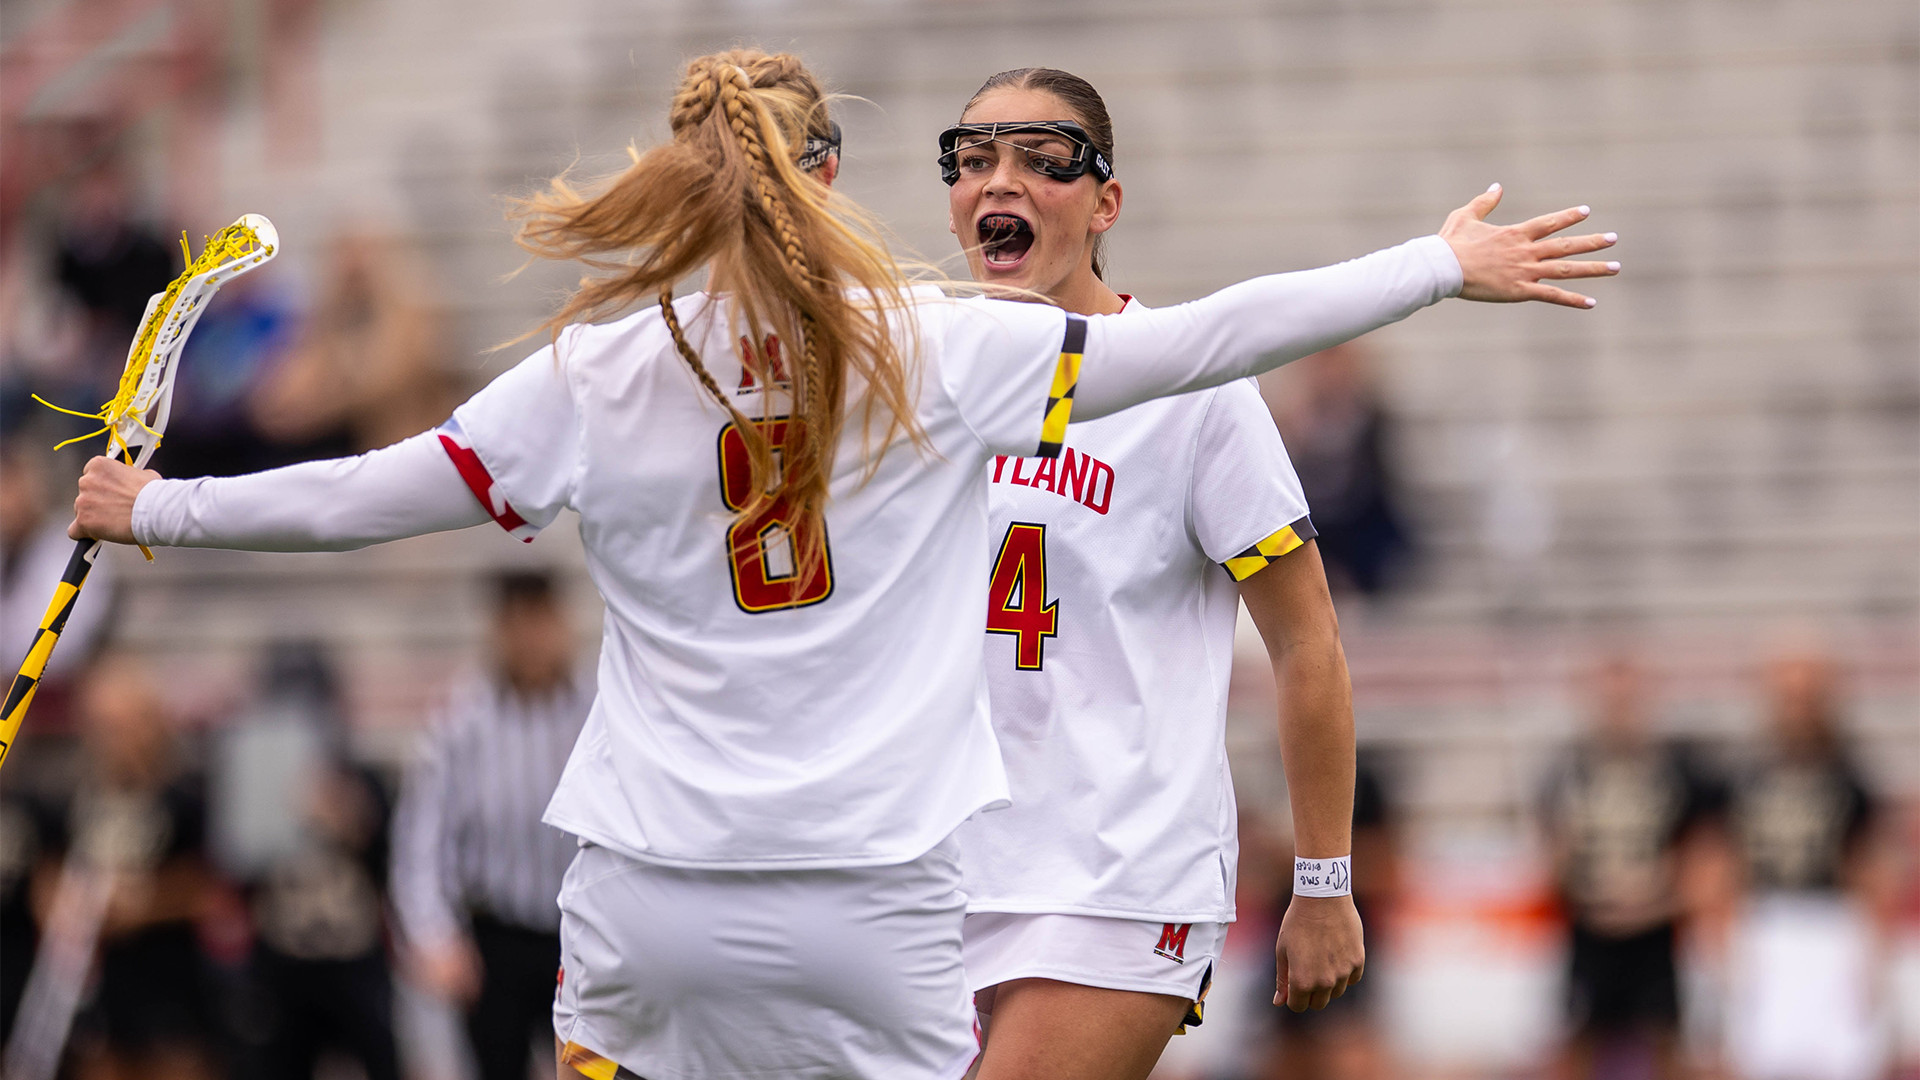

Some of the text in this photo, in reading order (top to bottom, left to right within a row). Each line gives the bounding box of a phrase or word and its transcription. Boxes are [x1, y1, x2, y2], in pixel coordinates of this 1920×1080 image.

[800, 150, 828, 169] GAIT
[1096, 153, 1110, 177] GAIT
[986, 216, 1018, 230] TERPS
[717, 414, 835, 615] 8
[986, 521, 1060, 672] 4
[1155, 923, 1192, 959] M
